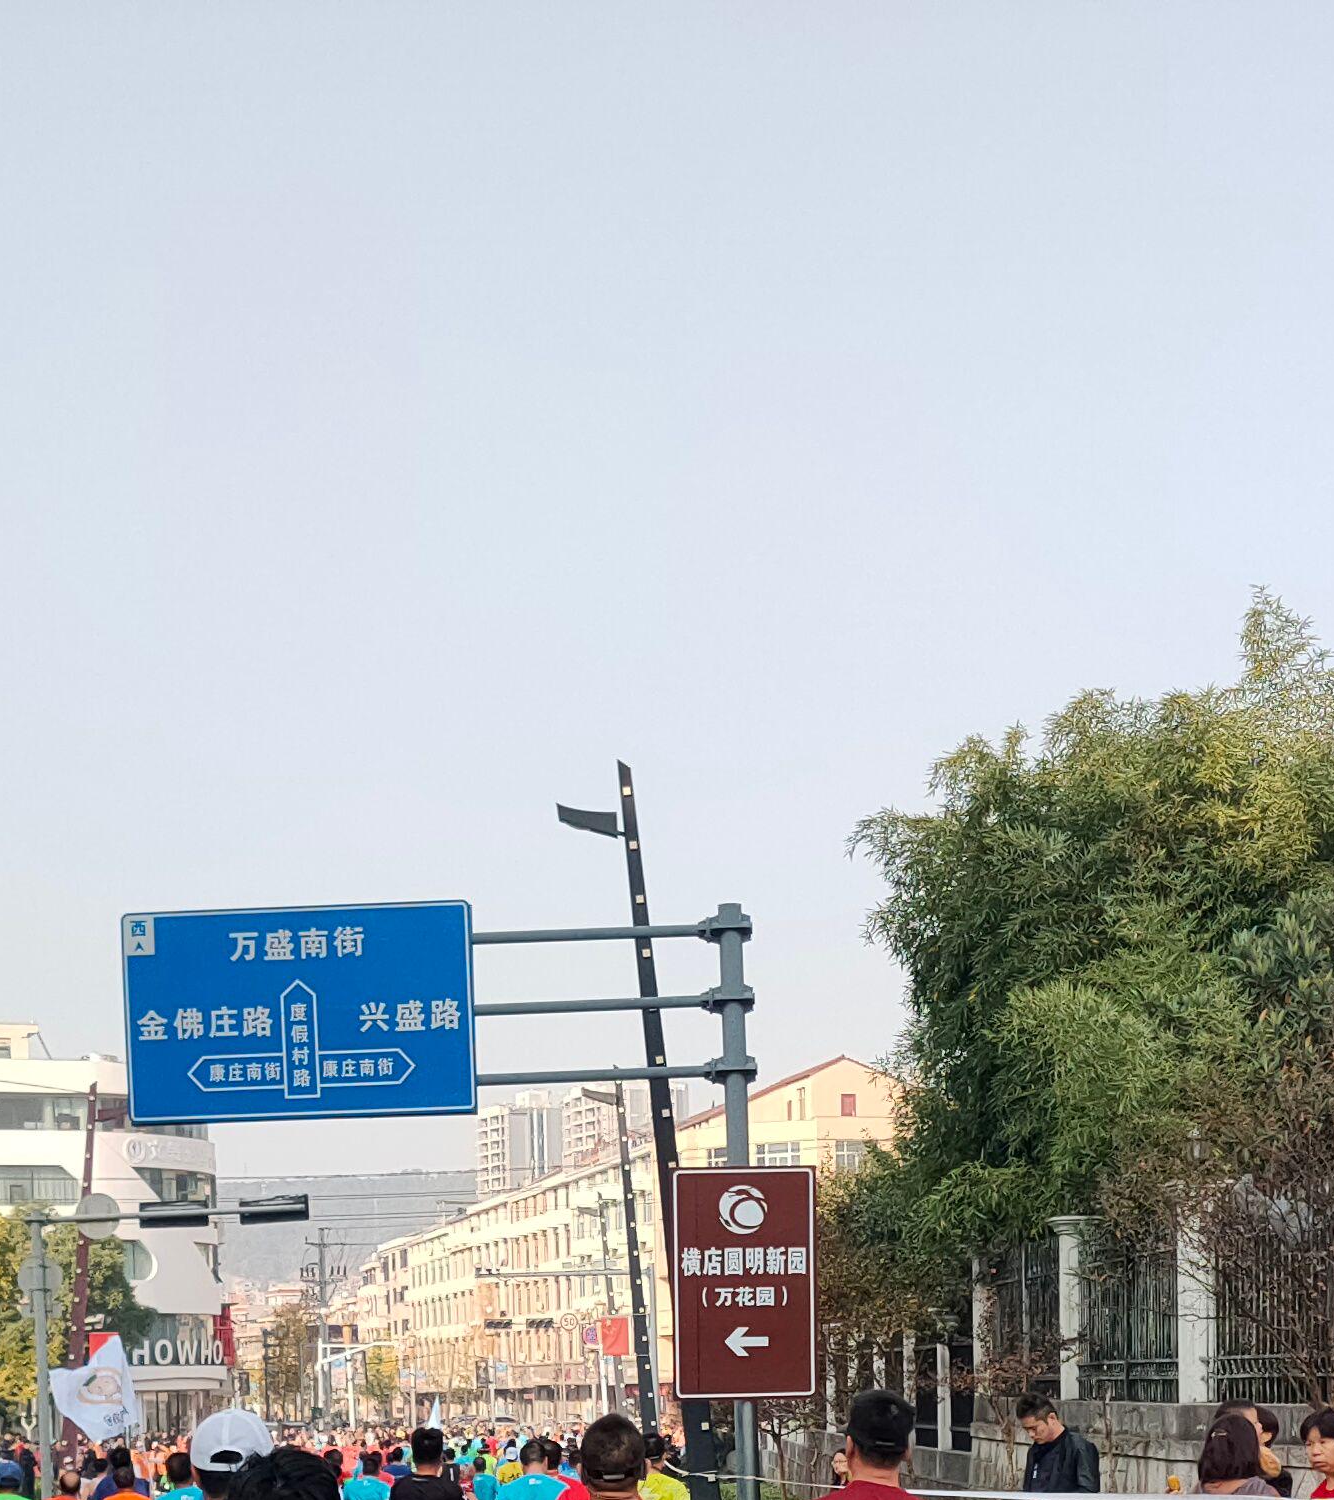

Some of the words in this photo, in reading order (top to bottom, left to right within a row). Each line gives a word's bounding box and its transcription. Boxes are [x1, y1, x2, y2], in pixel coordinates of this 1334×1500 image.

[130, 920, 147, 937] 西
[229, 926, 365, 961] 万盛南街
[137, 1006, 273, 1041] 金佛庄路
[359, 998, 461, 1033] 兴盛路
[289, 1002, 311, 1088] 度假村路
[209, 1062, 281, 1082] 康庄南街
[323, 1057, 394, 1079] 康庄南街
[681, 1247, 807, 1276] 横店圆明新园
[701, 1286, 788, 1307] （万花园）
